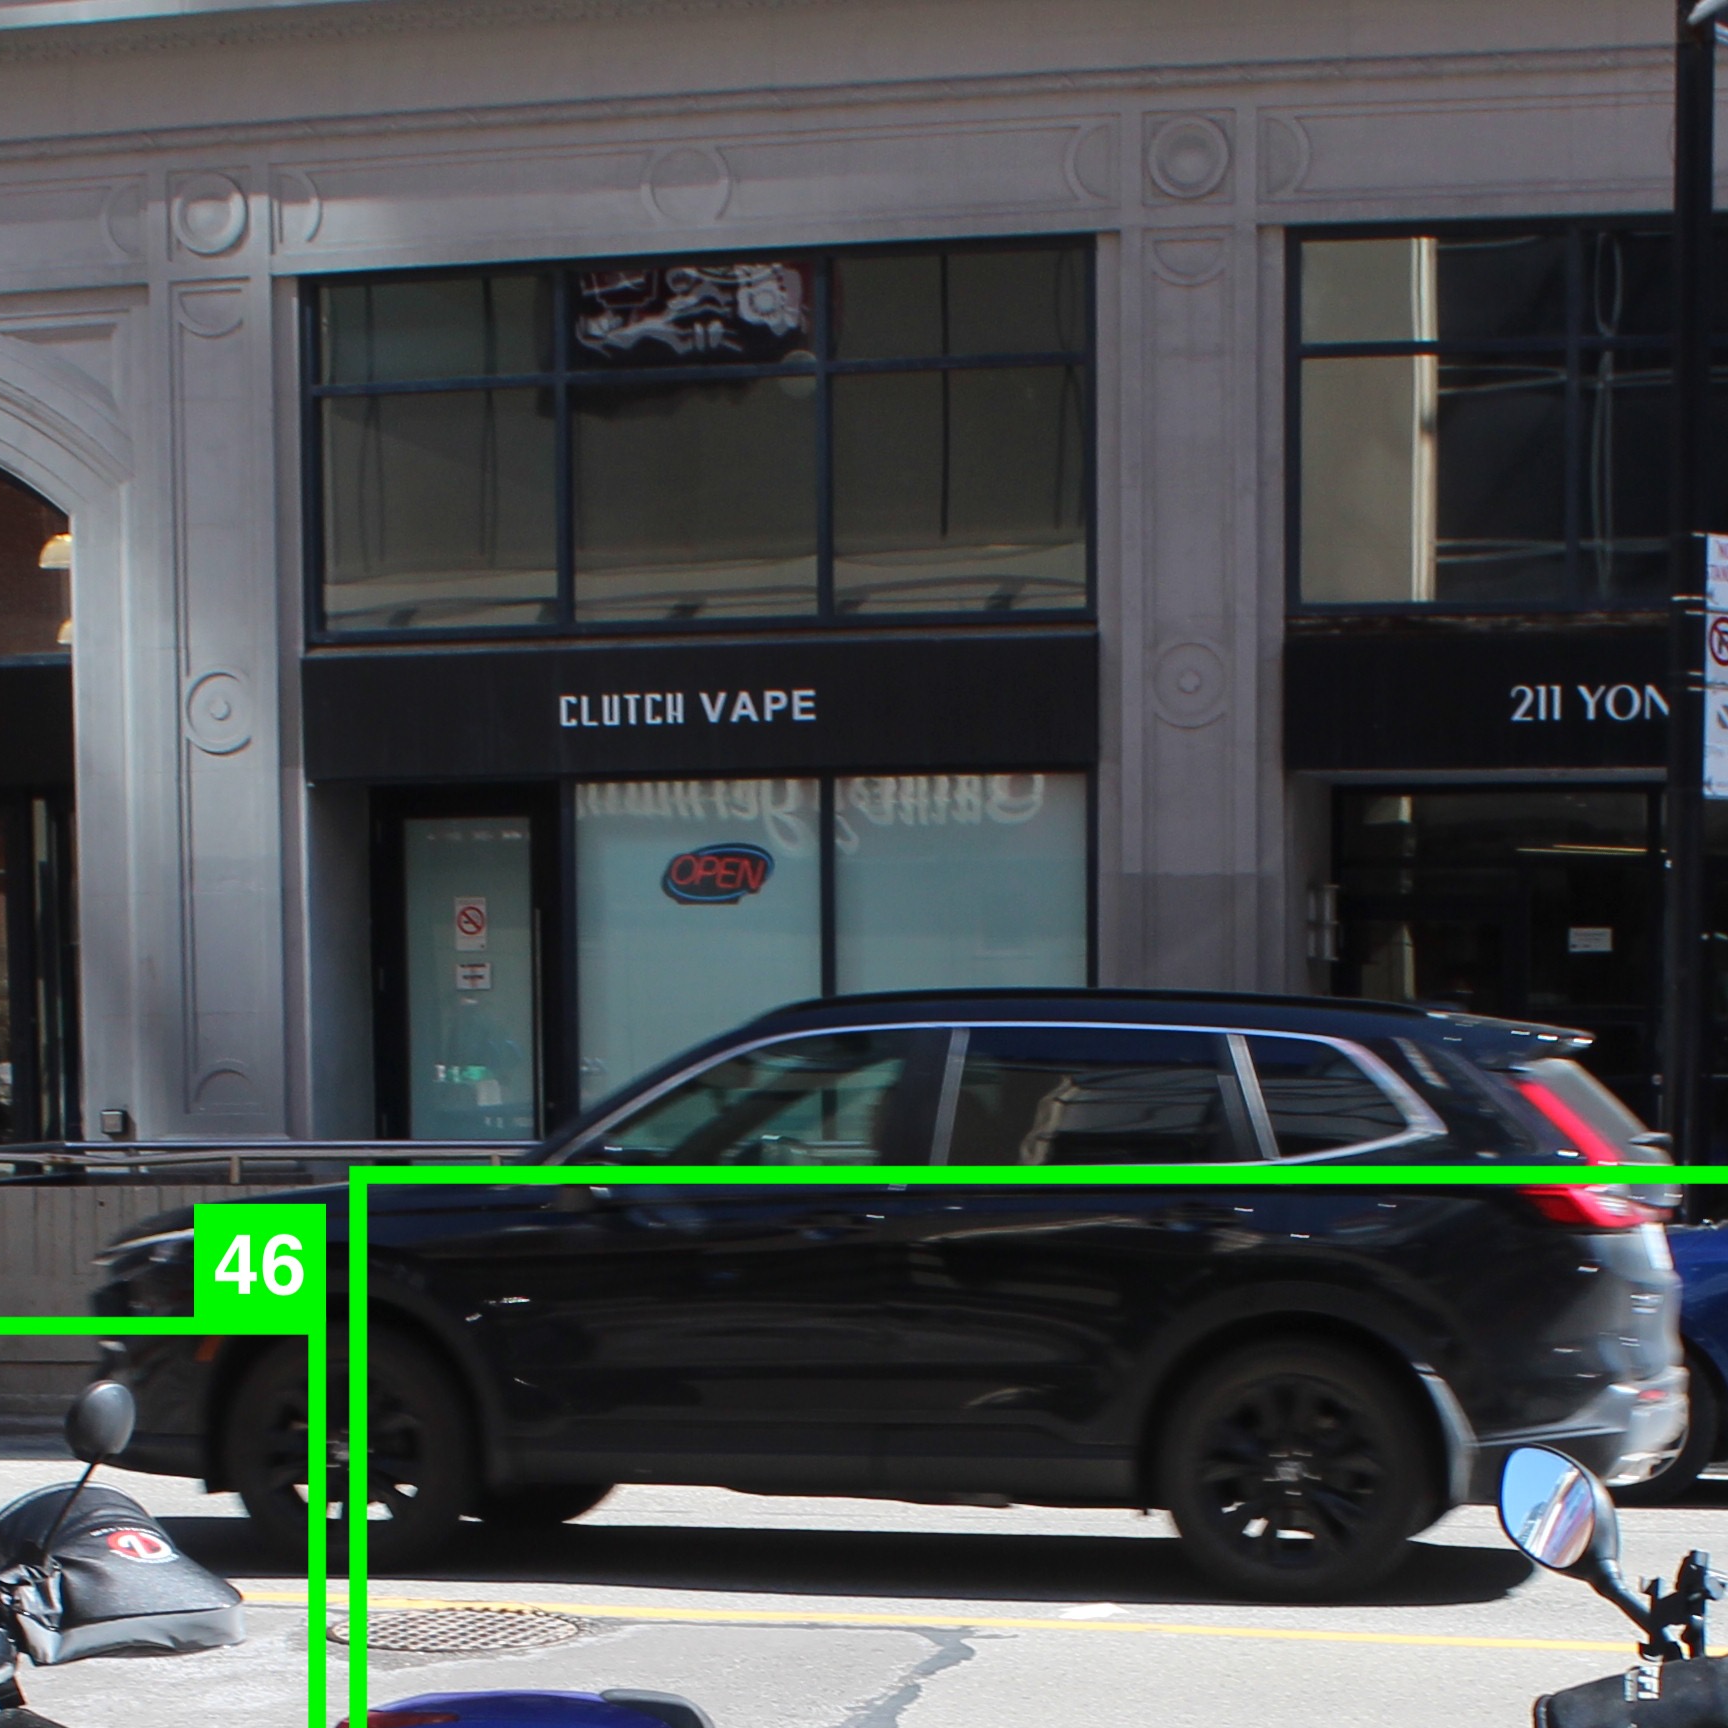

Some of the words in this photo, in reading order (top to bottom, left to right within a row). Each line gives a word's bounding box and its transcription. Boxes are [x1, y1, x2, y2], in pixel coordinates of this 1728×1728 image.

[559, 692, 684, 727] CLUTCH
[699, 689, 816, 723] VAPE
[1510, 684, 1562, 721] 211
[1576, 684, 1670, 720] YON
[669, 853, 766, 889] OPEN
